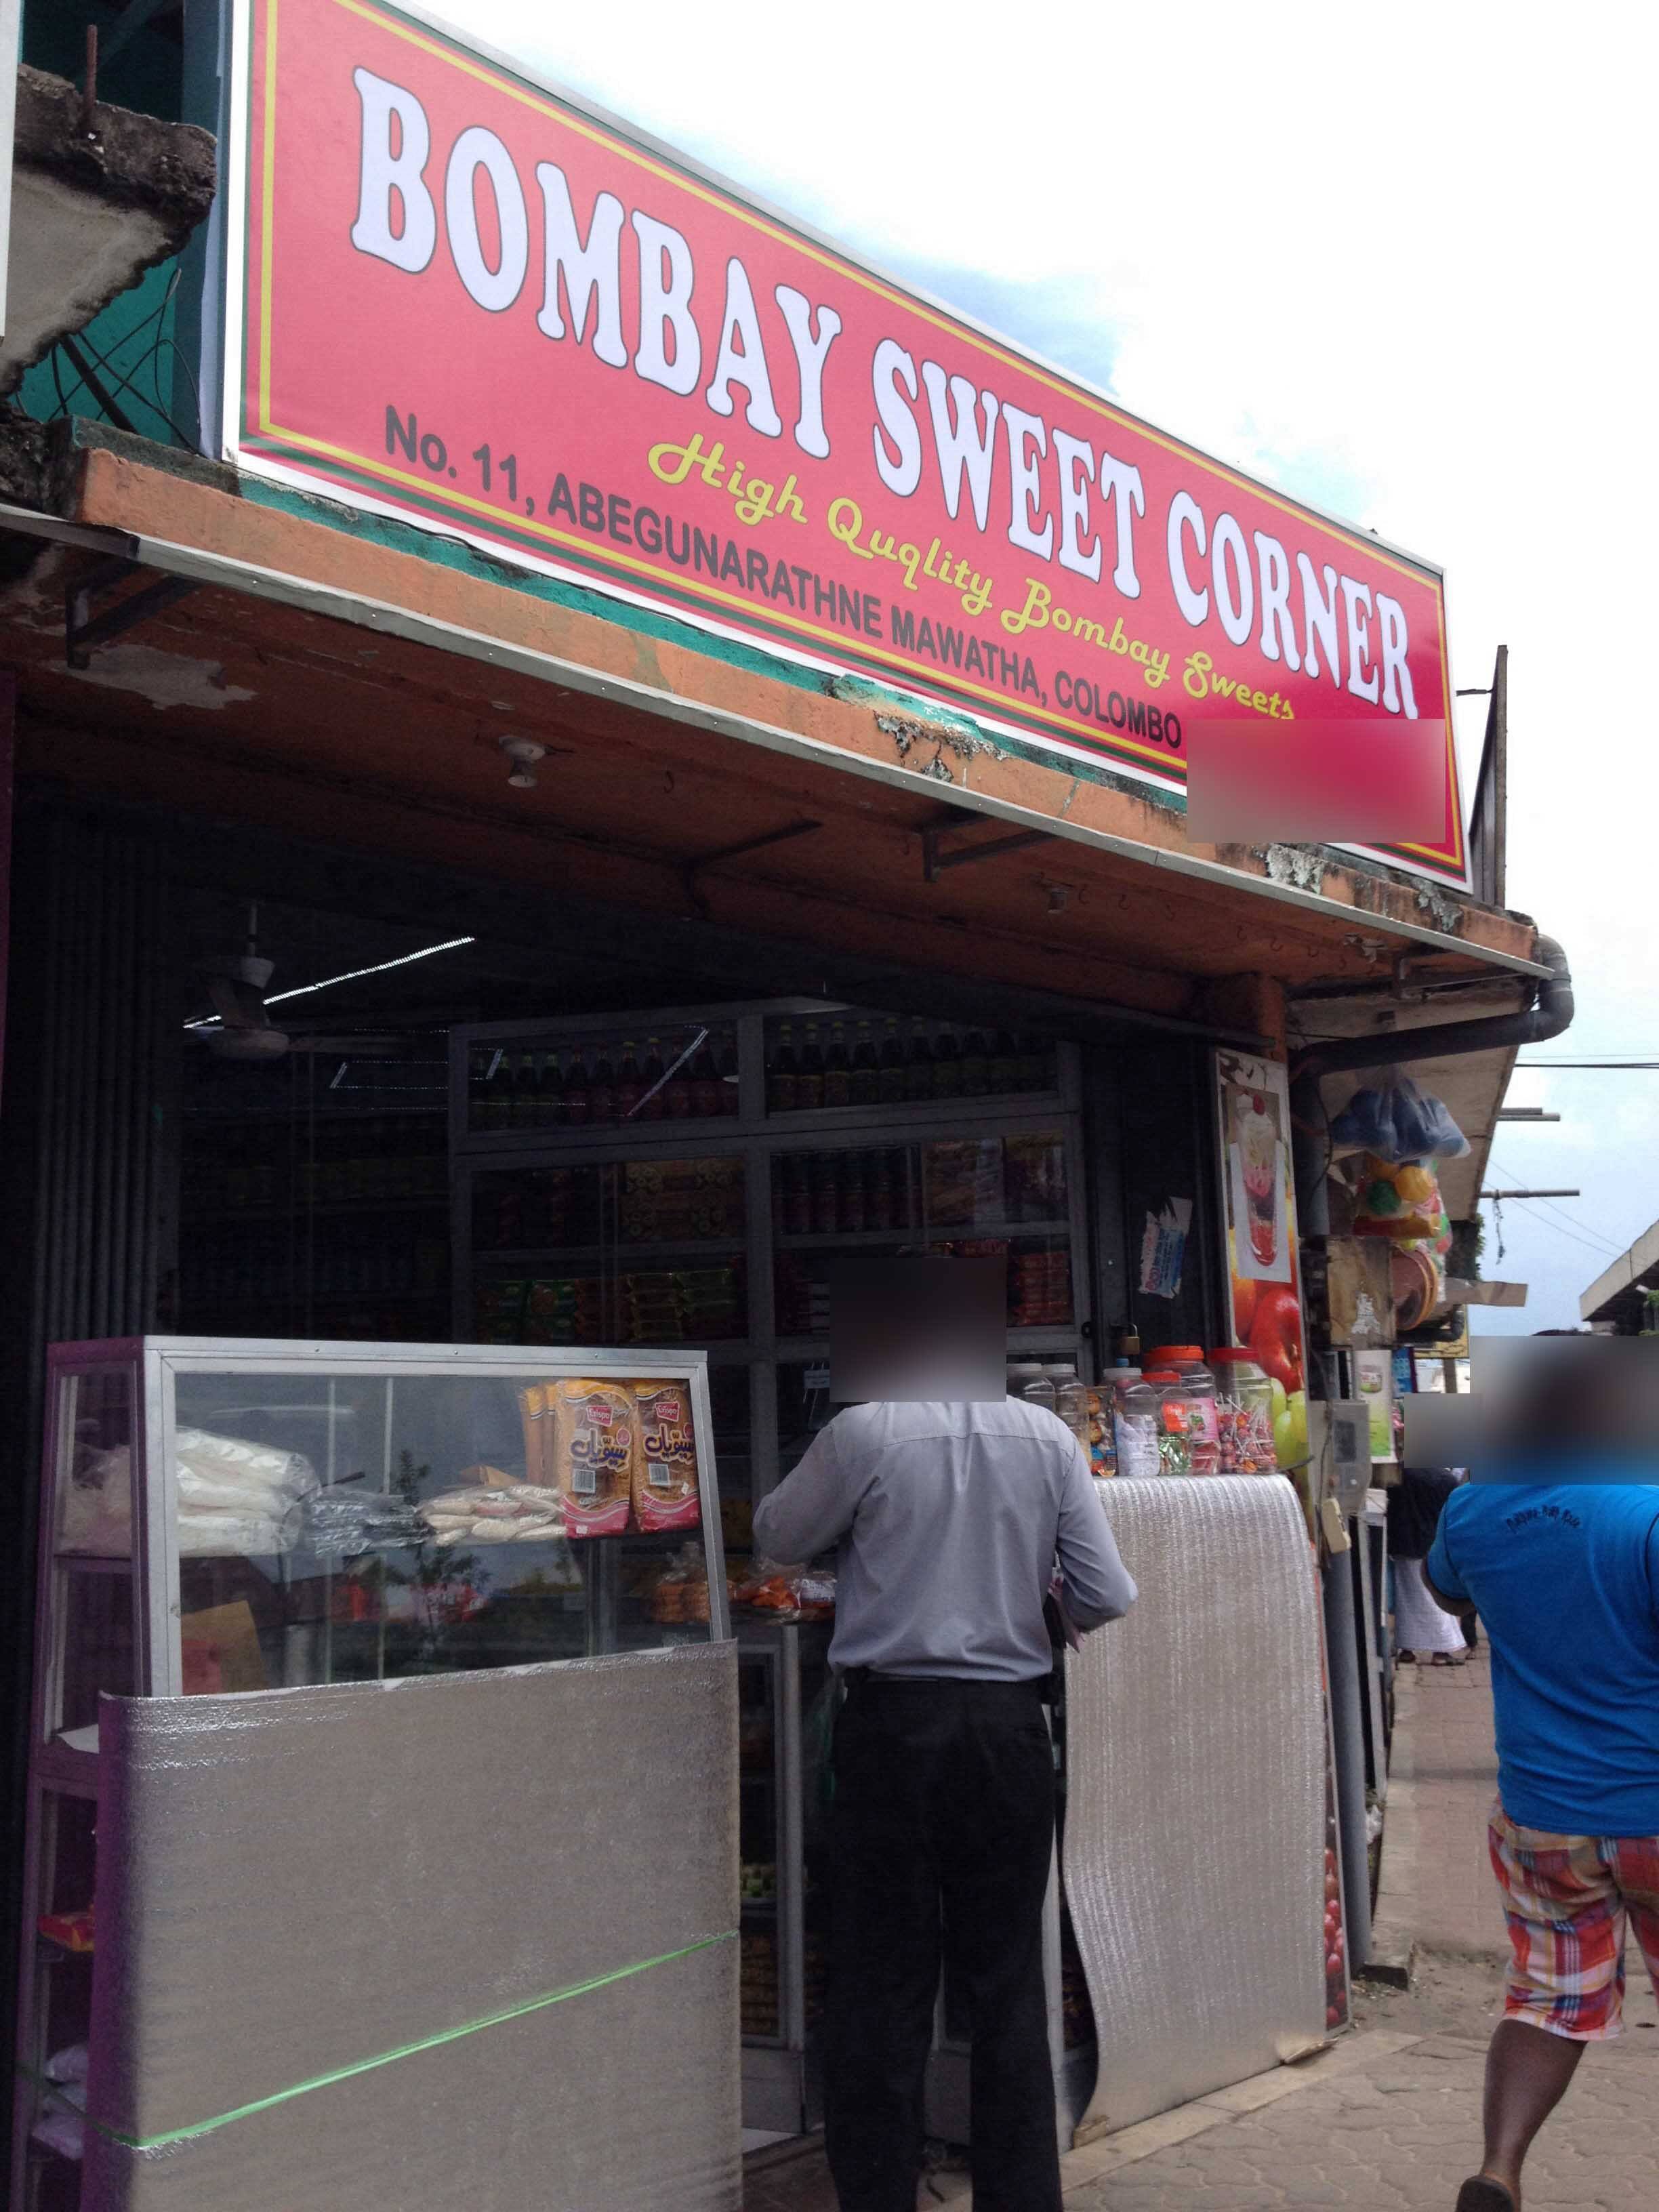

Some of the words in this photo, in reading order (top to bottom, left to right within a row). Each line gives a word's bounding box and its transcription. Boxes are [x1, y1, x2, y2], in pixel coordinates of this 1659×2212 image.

[350, 66, 842, 459] BOMBAY
[872, 338, 1145, 599] SWEET
[1167, 490, 1418, 719] CORNER
[386, 405, 457, 478] No.
[473, 444, 535, 516] 11,
[548, 473, 882, 638] ABEGUNARATHNE
[892, 605, 1047, 706] MAWATHA,
[1055, 670, 1182, 749] COLOMBO
[648, 433, 808, 525] High
[1001, 578, 1170, 689] Bombay
[1183, 651, 1294, 719] Sweets
